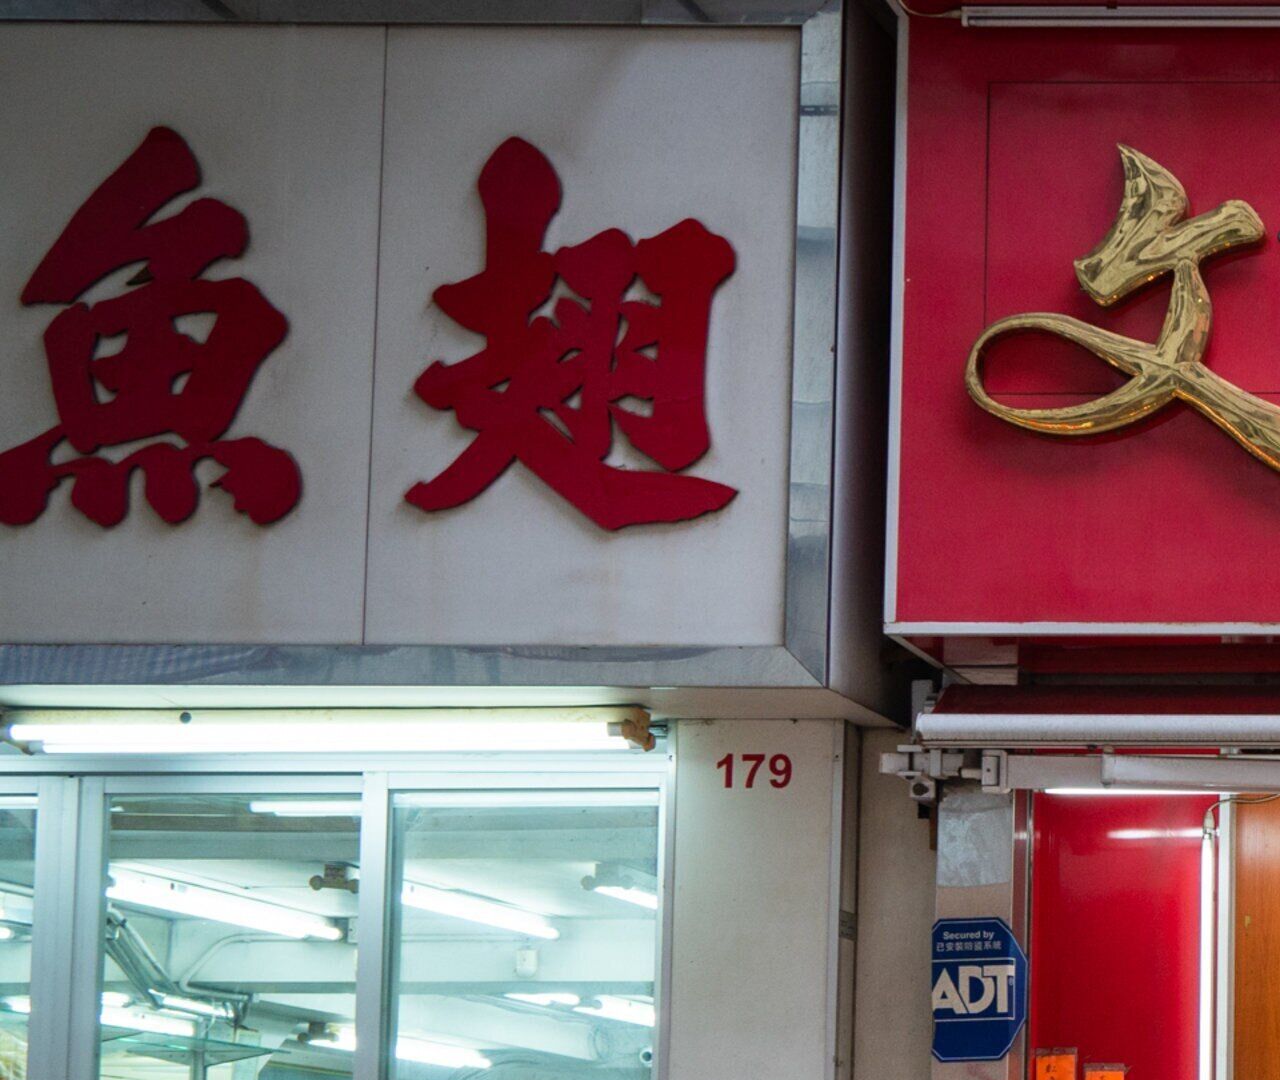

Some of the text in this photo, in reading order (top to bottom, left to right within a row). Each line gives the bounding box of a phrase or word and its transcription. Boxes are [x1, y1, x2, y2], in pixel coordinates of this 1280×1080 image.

[716, 753, 793, 790] 179
[943, 931, 995, 940] Secured by
[932, 964, 1016, 1015] ADT
